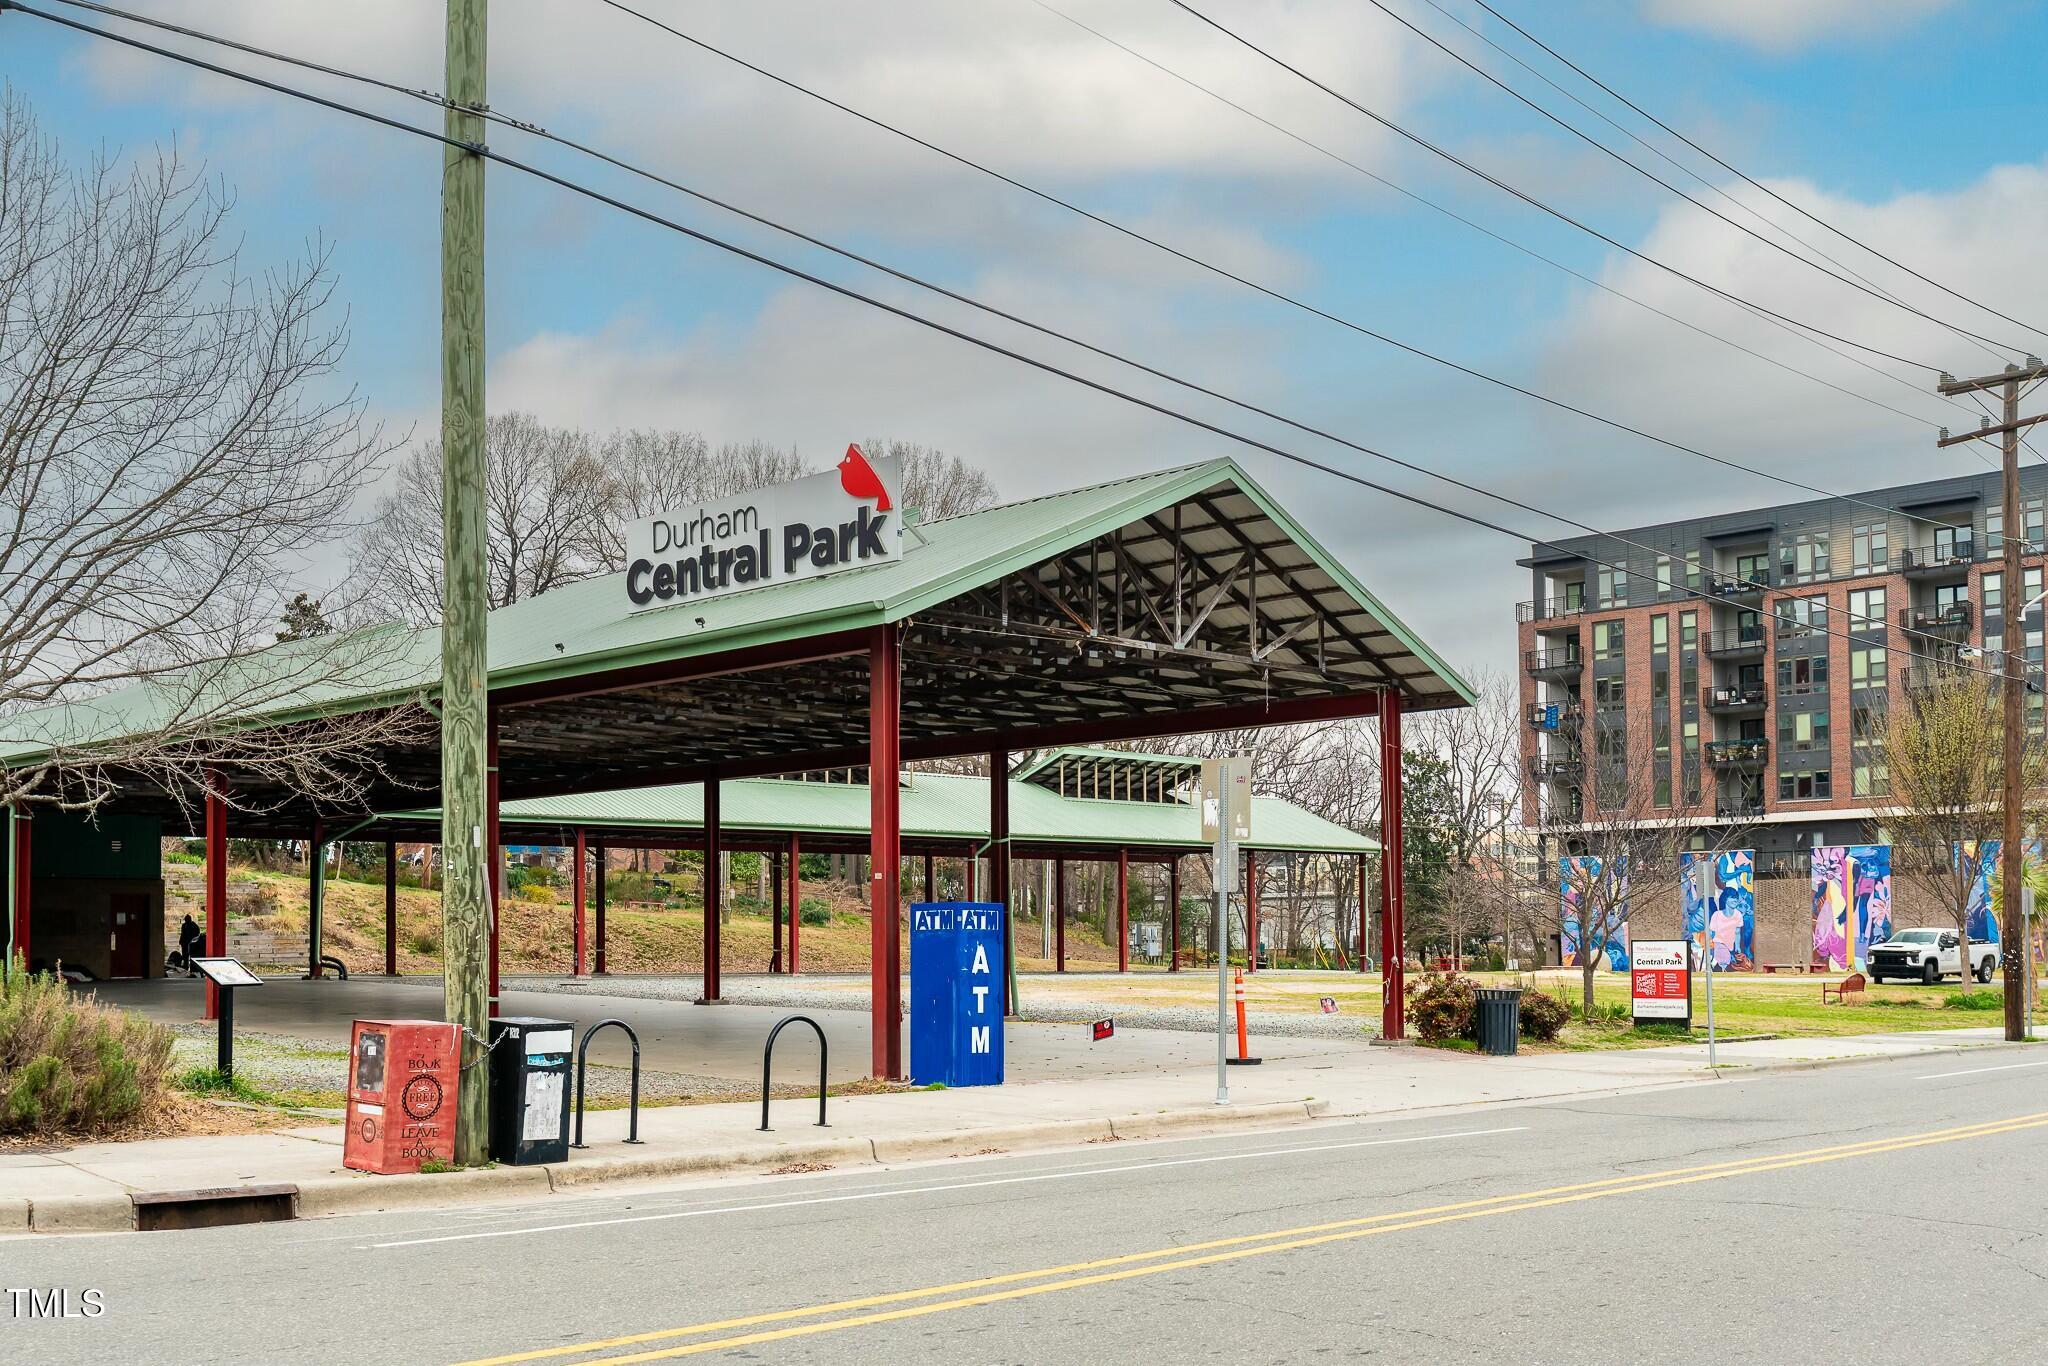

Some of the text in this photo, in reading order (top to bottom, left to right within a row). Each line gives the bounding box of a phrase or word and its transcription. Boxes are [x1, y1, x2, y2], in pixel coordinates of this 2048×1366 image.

[652, 505, 759, 554] Durham
[626, 505, 889, 605] Central Park
[915, 909, 999, 931] ATM ATM
[409, 1092, 437, 1103] FREE
[401, 1127, 440, 1139] LEAVE
[415, 1138, 424, 1148] A
[402, 1147, 436, 1159] BOOK
